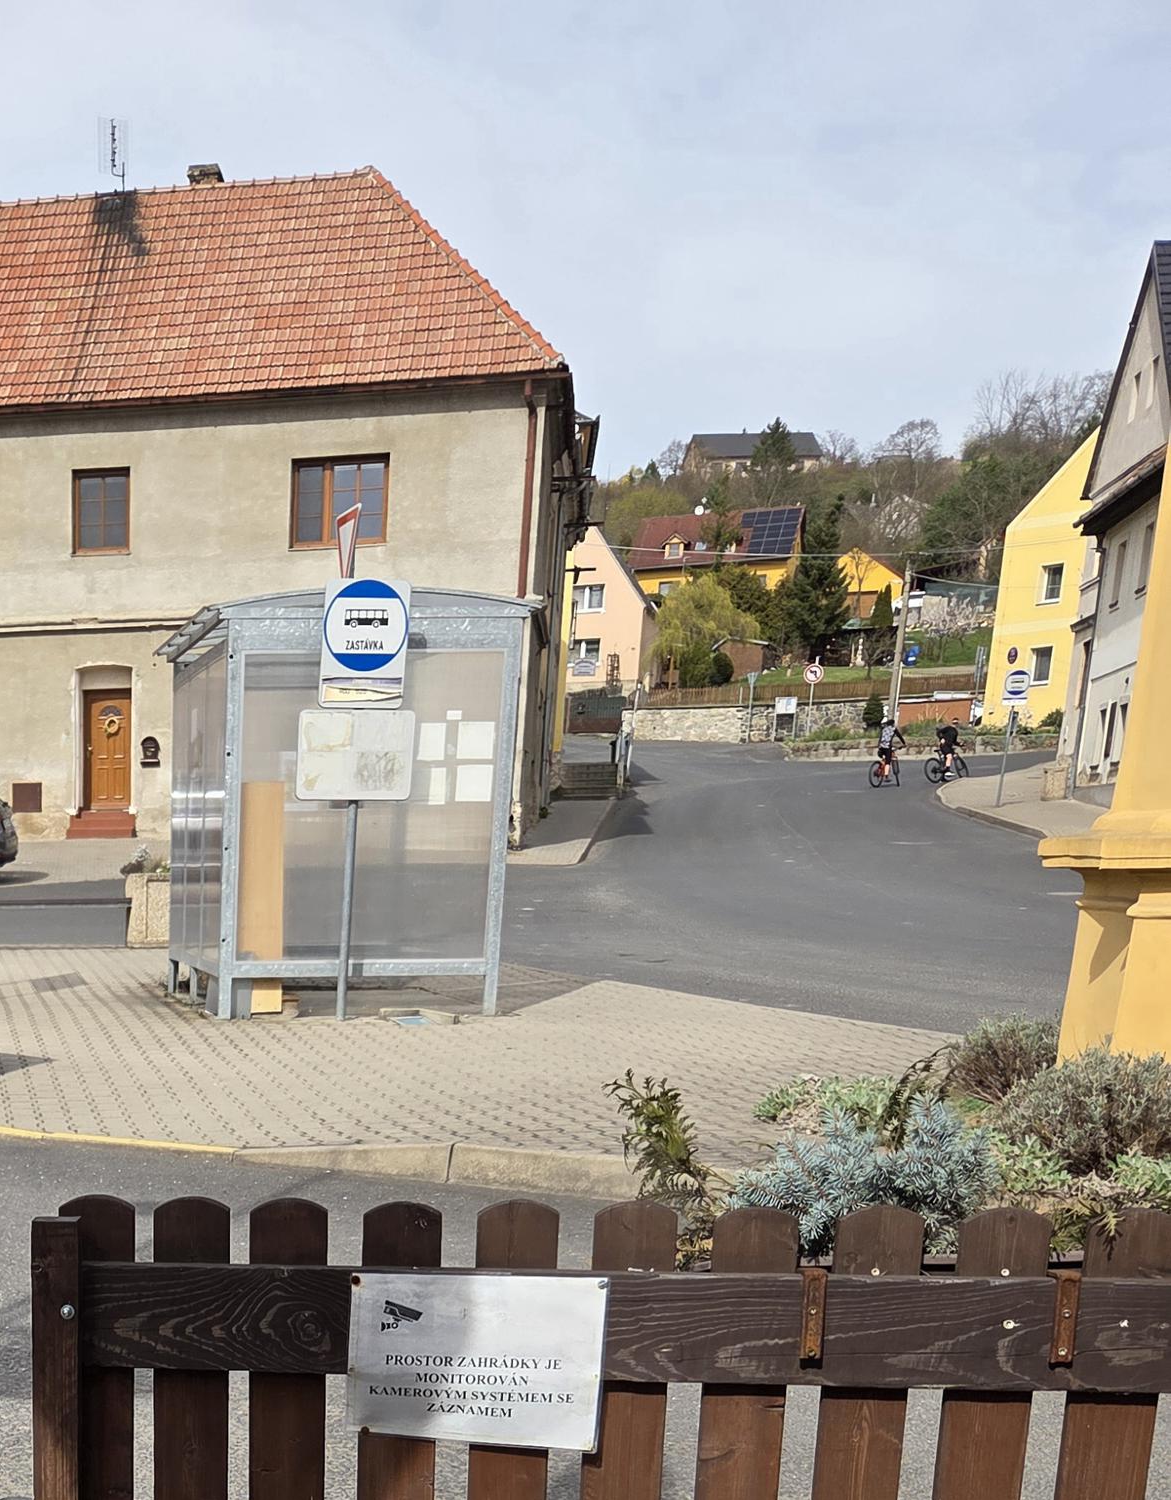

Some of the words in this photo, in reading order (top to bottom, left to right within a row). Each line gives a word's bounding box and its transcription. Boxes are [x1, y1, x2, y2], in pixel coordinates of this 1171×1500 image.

[345, 637, 384, 651] ZASTÁVKA
[385, 1354, 454, 1367] PROSTOR
[457, 1354, 541, 1370] ZAHRÁDKY
[545, 1359, 563, 1370] JE
[415, 1372, 529, 1386] MONITOROVÁN
[369, 1385, 467, 1400] KAMEROVÝM
[471, 1389, 552, 1404] SYSTÉMEM
[556, 1392, 575, 1404] SE
[426, 1401, 513, 1418] ZÁZNAMEM
